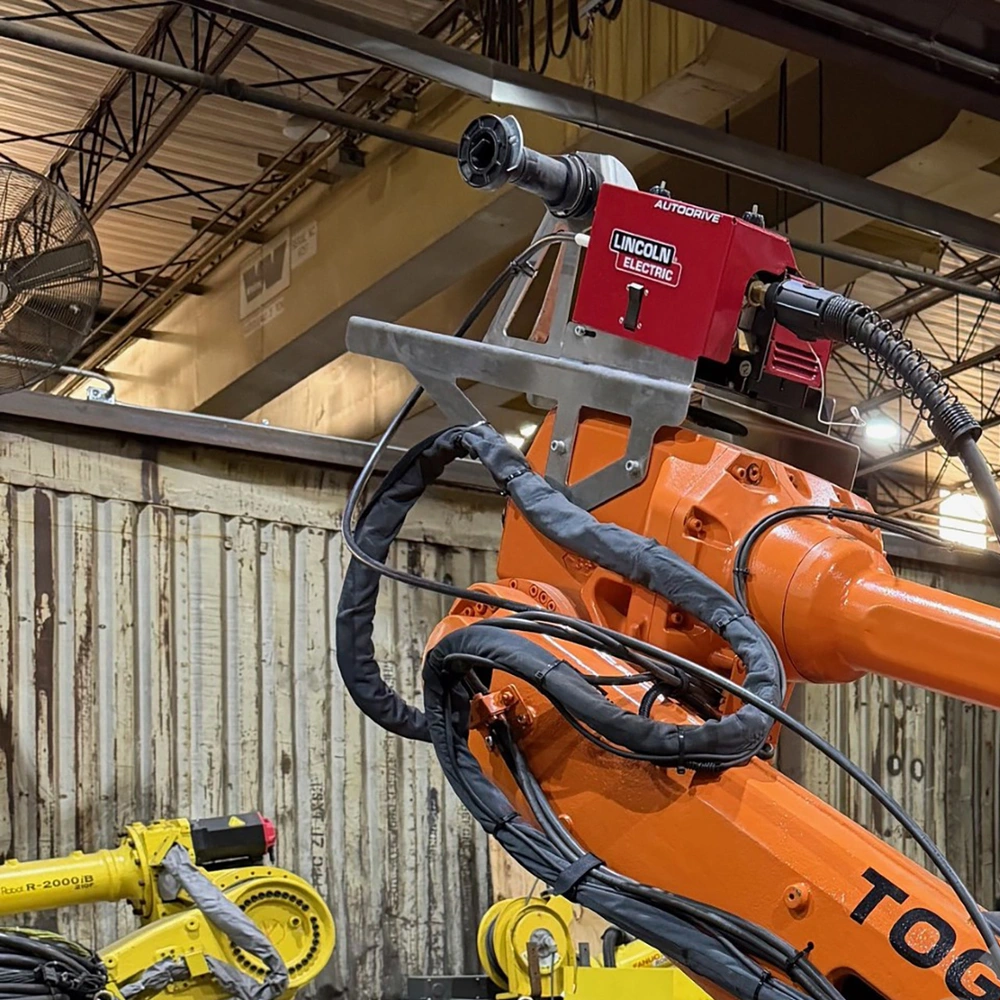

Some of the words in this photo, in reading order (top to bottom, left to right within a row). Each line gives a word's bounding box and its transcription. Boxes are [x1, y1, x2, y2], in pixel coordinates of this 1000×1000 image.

[654, 199, 720, 224] AUTODRIVE
[613, 233, 672, 264] LINCOLN
[623, 256, 674, 282] ELECTRIC
[26, 875, 94, 891] R-2000iB
